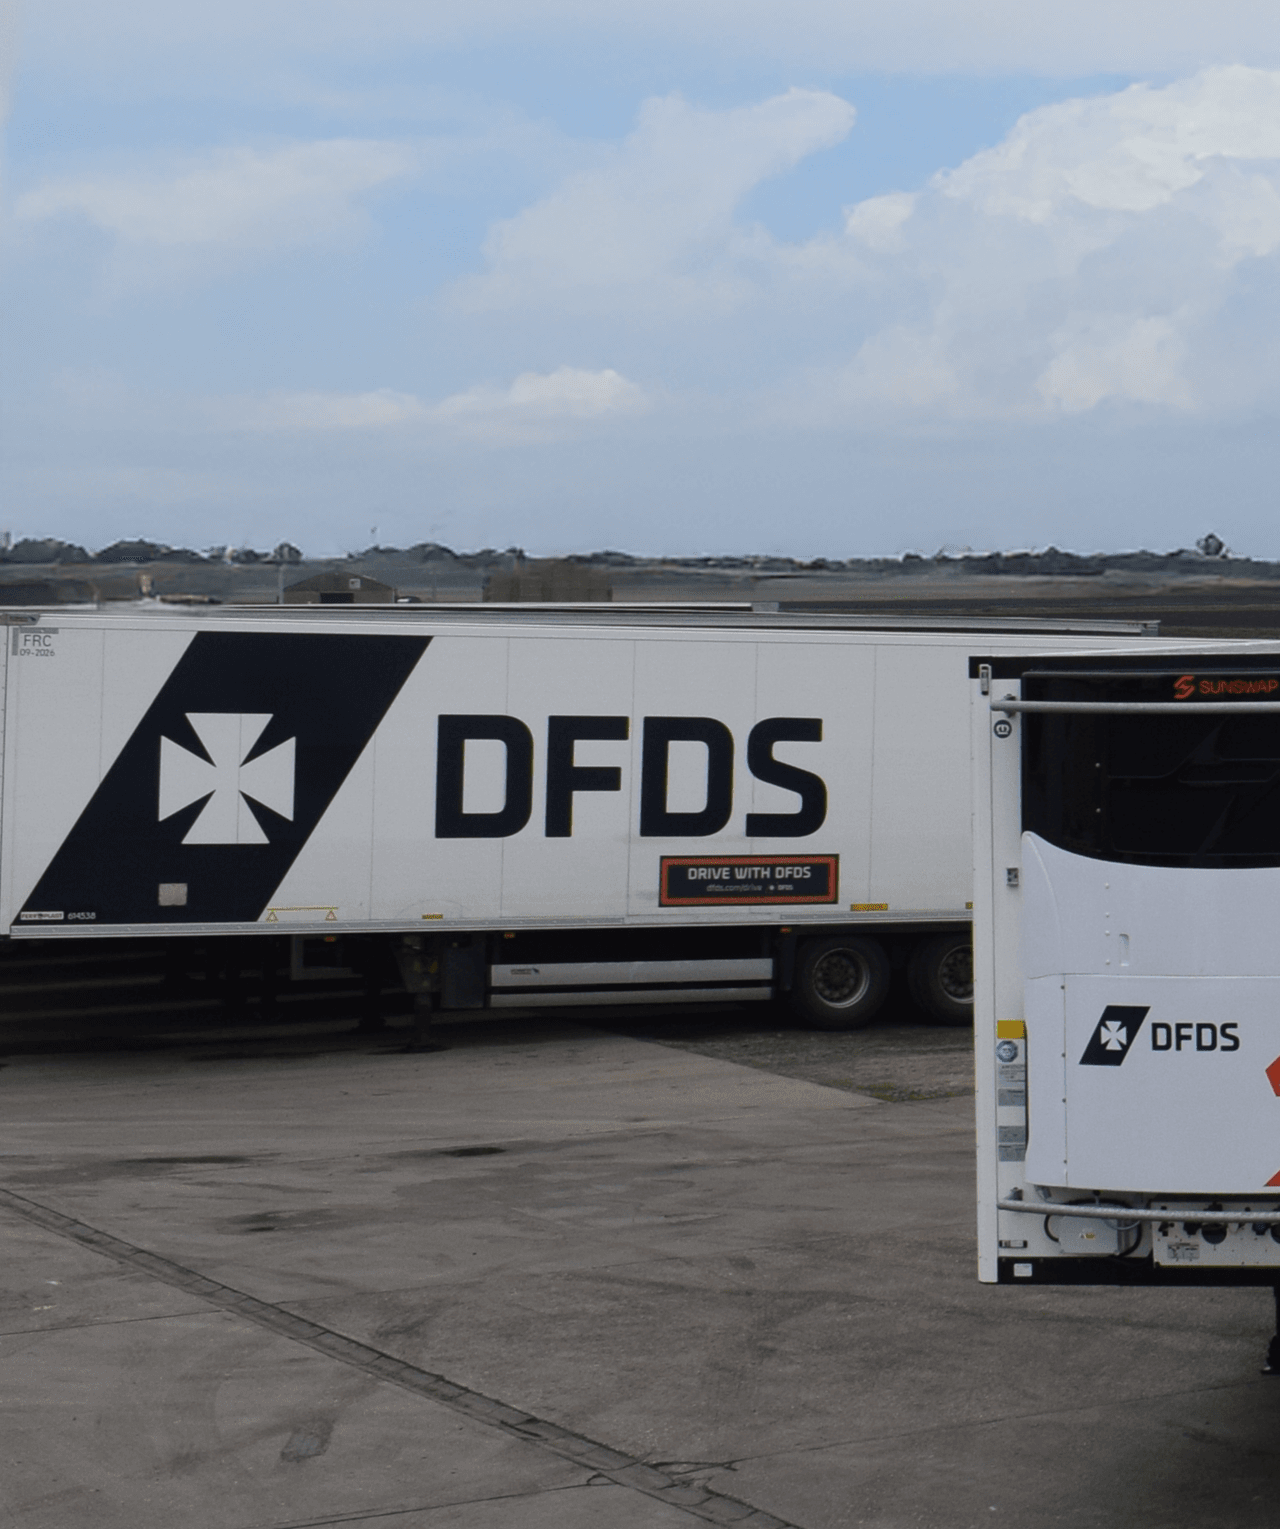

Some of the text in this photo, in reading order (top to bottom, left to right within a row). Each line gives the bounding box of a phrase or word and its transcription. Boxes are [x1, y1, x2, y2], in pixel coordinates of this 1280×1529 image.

[23, 634, 52, 647] FRC
[20, 648, 55, 657] 09-2026
[1200, 680, 1279, 694] SUNSWAP
[435, 714, 828, 838] DFDS
[688, 866, 811, 880] DRIVE WITH DFDS
[1151, 1022, 1240, 1052] DFDS
